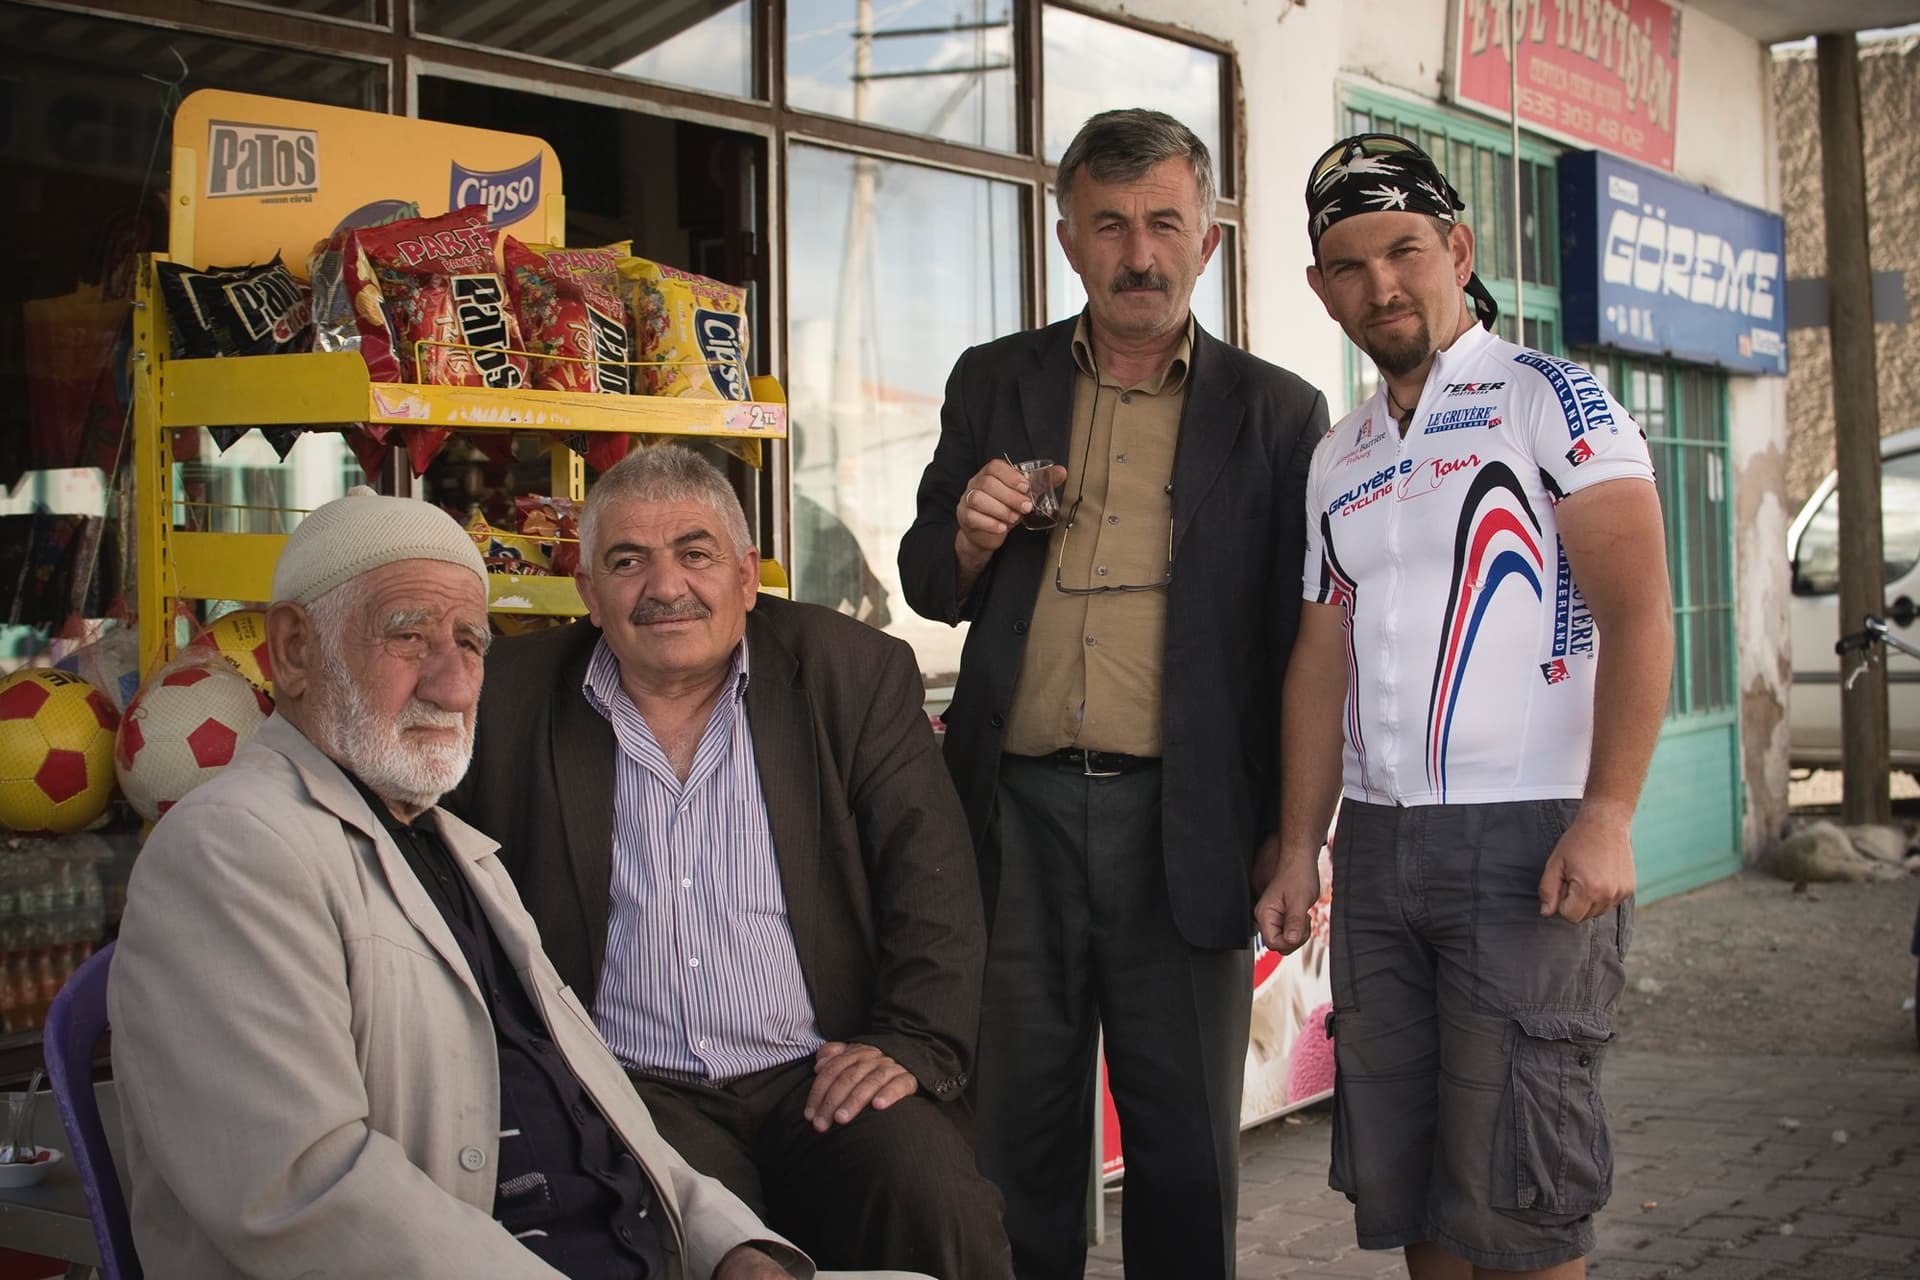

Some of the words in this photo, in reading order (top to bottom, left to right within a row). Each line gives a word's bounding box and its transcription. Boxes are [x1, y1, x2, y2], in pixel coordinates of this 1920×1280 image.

[457, 175, 534, 222] Cipso
[1604, 203, 1778, 320] GÖREME
[704, 318, 746, 400] Cipso
[1519, 354, 1581, 432] SWITZERLAND
[1427, 413, 1441, 426] LE
[1342, 482, 1393, 517] CYCLING
[1431, 454, 1481, 479] Tour
